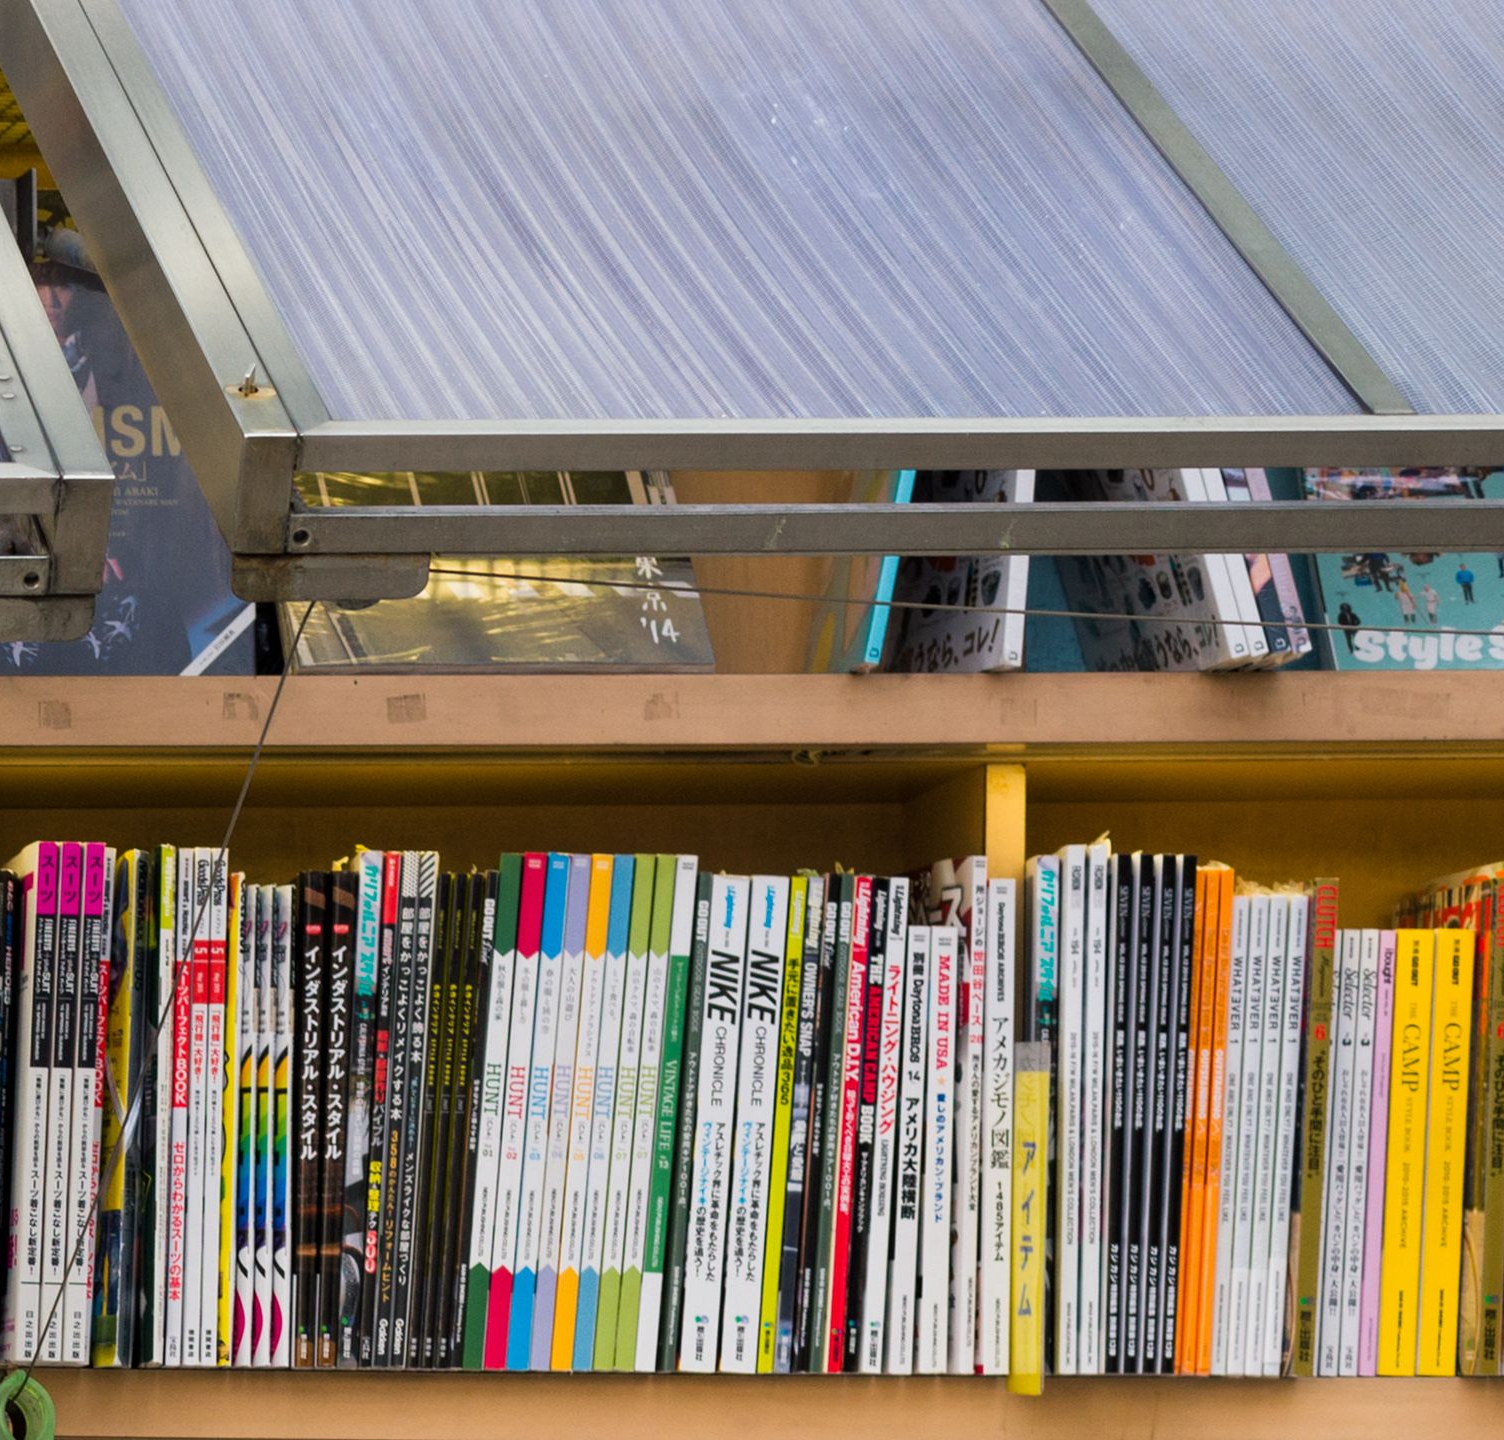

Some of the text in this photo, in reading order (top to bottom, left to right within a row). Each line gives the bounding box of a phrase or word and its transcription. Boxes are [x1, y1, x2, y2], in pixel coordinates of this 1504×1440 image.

[707, 950, 740, 1107] NIKE CHRONICLE
[747, 950, 780, 1107] NIKE CHRONICLE
[991, 1017, 1009, 1169] アメカジモノ図鑑
